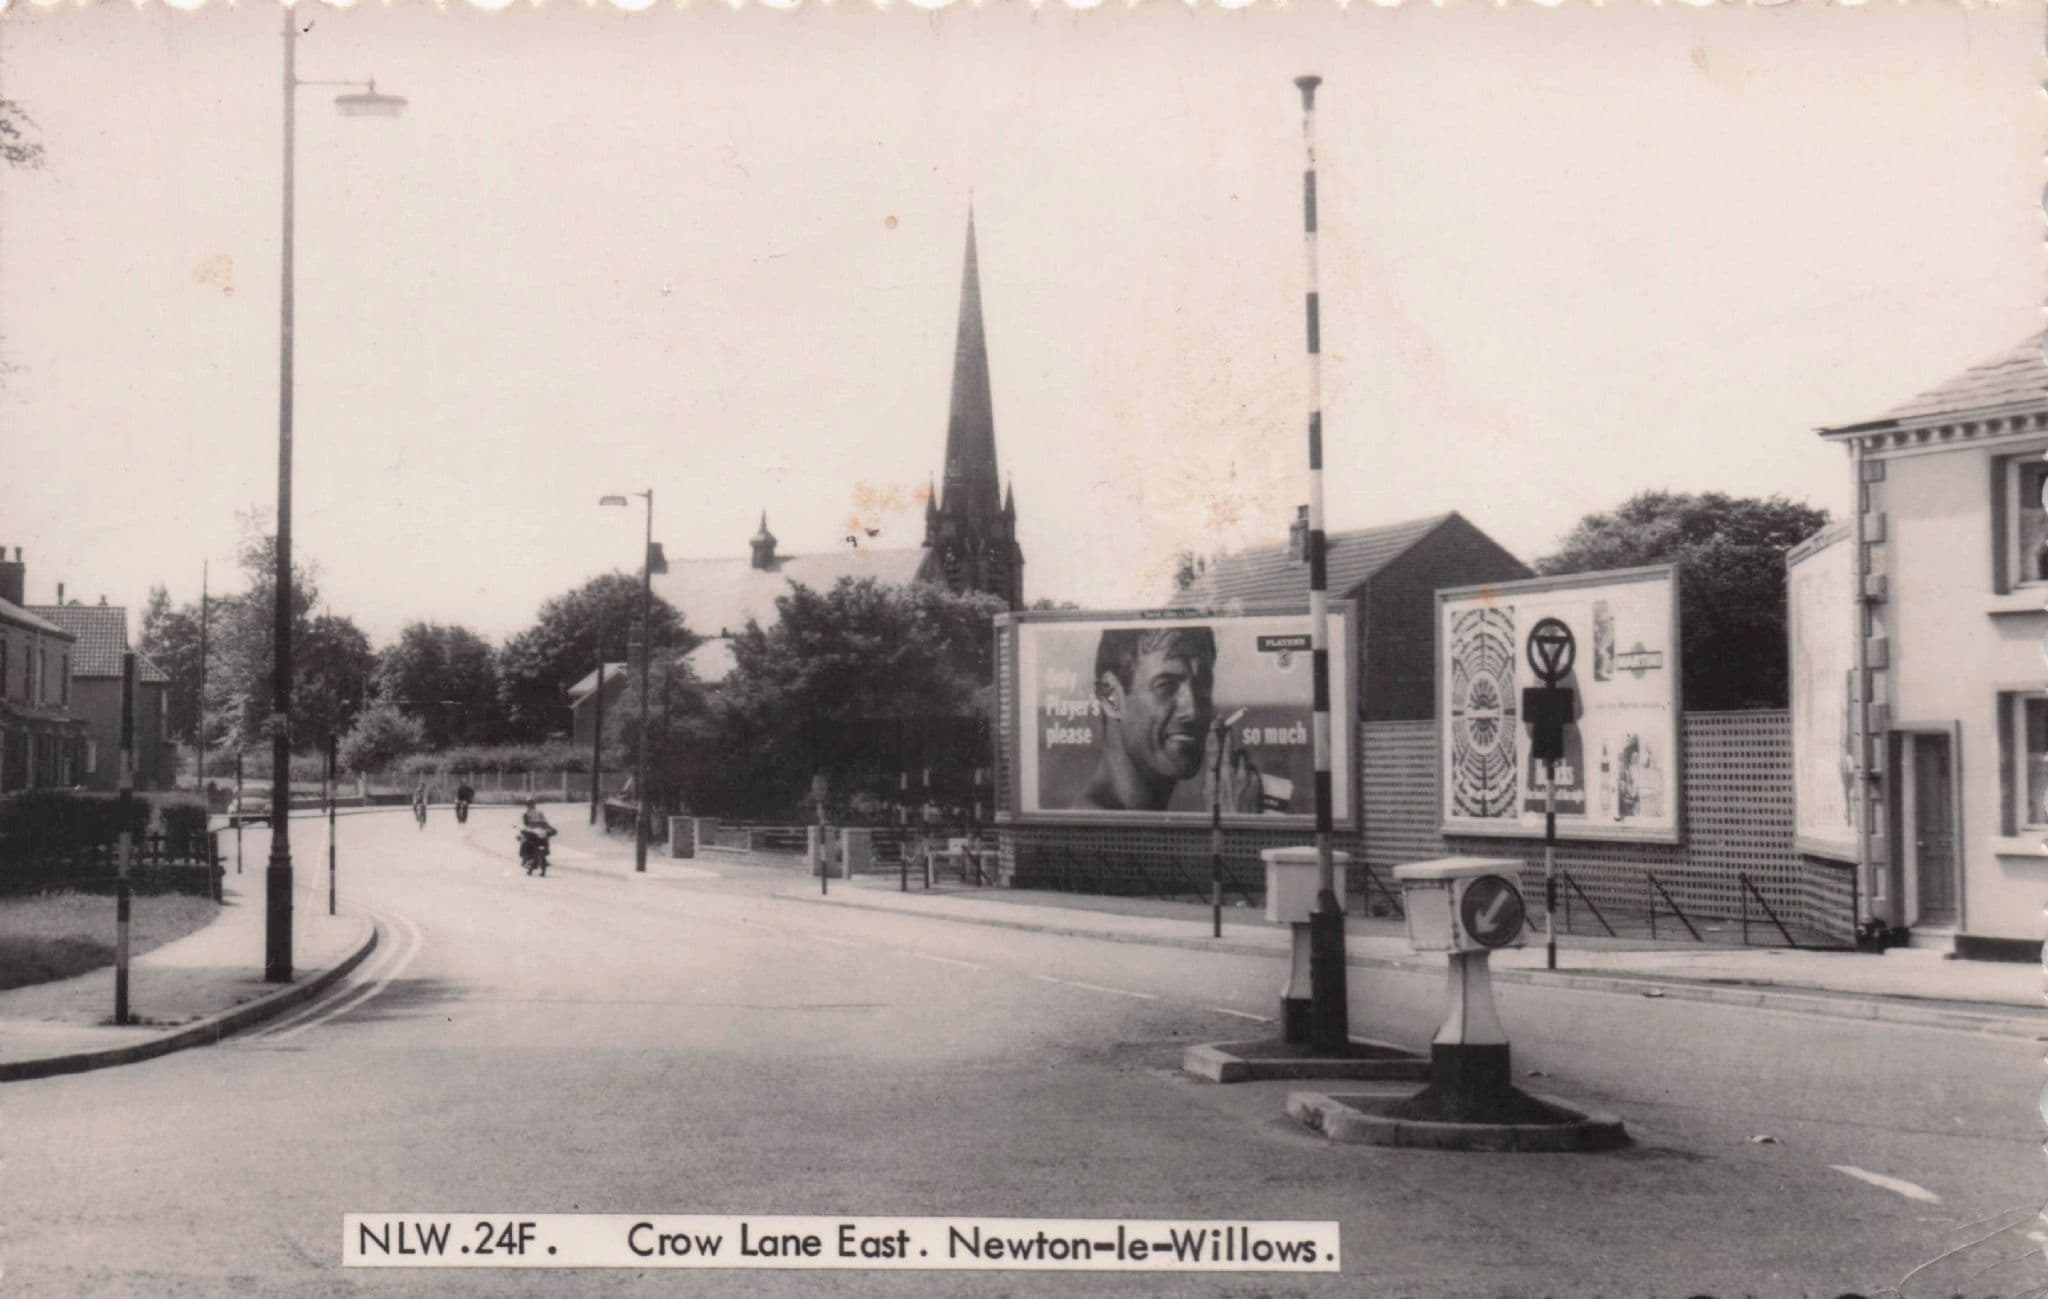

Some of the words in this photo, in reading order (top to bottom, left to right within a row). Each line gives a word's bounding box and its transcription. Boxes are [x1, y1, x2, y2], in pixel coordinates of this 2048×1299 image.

[1046, 694, 1100, 720] Player's
[1046, 722, 1093, 749] please
[1242, 727, 1261, 745] so
[1264, 720, 1307, 745] much
